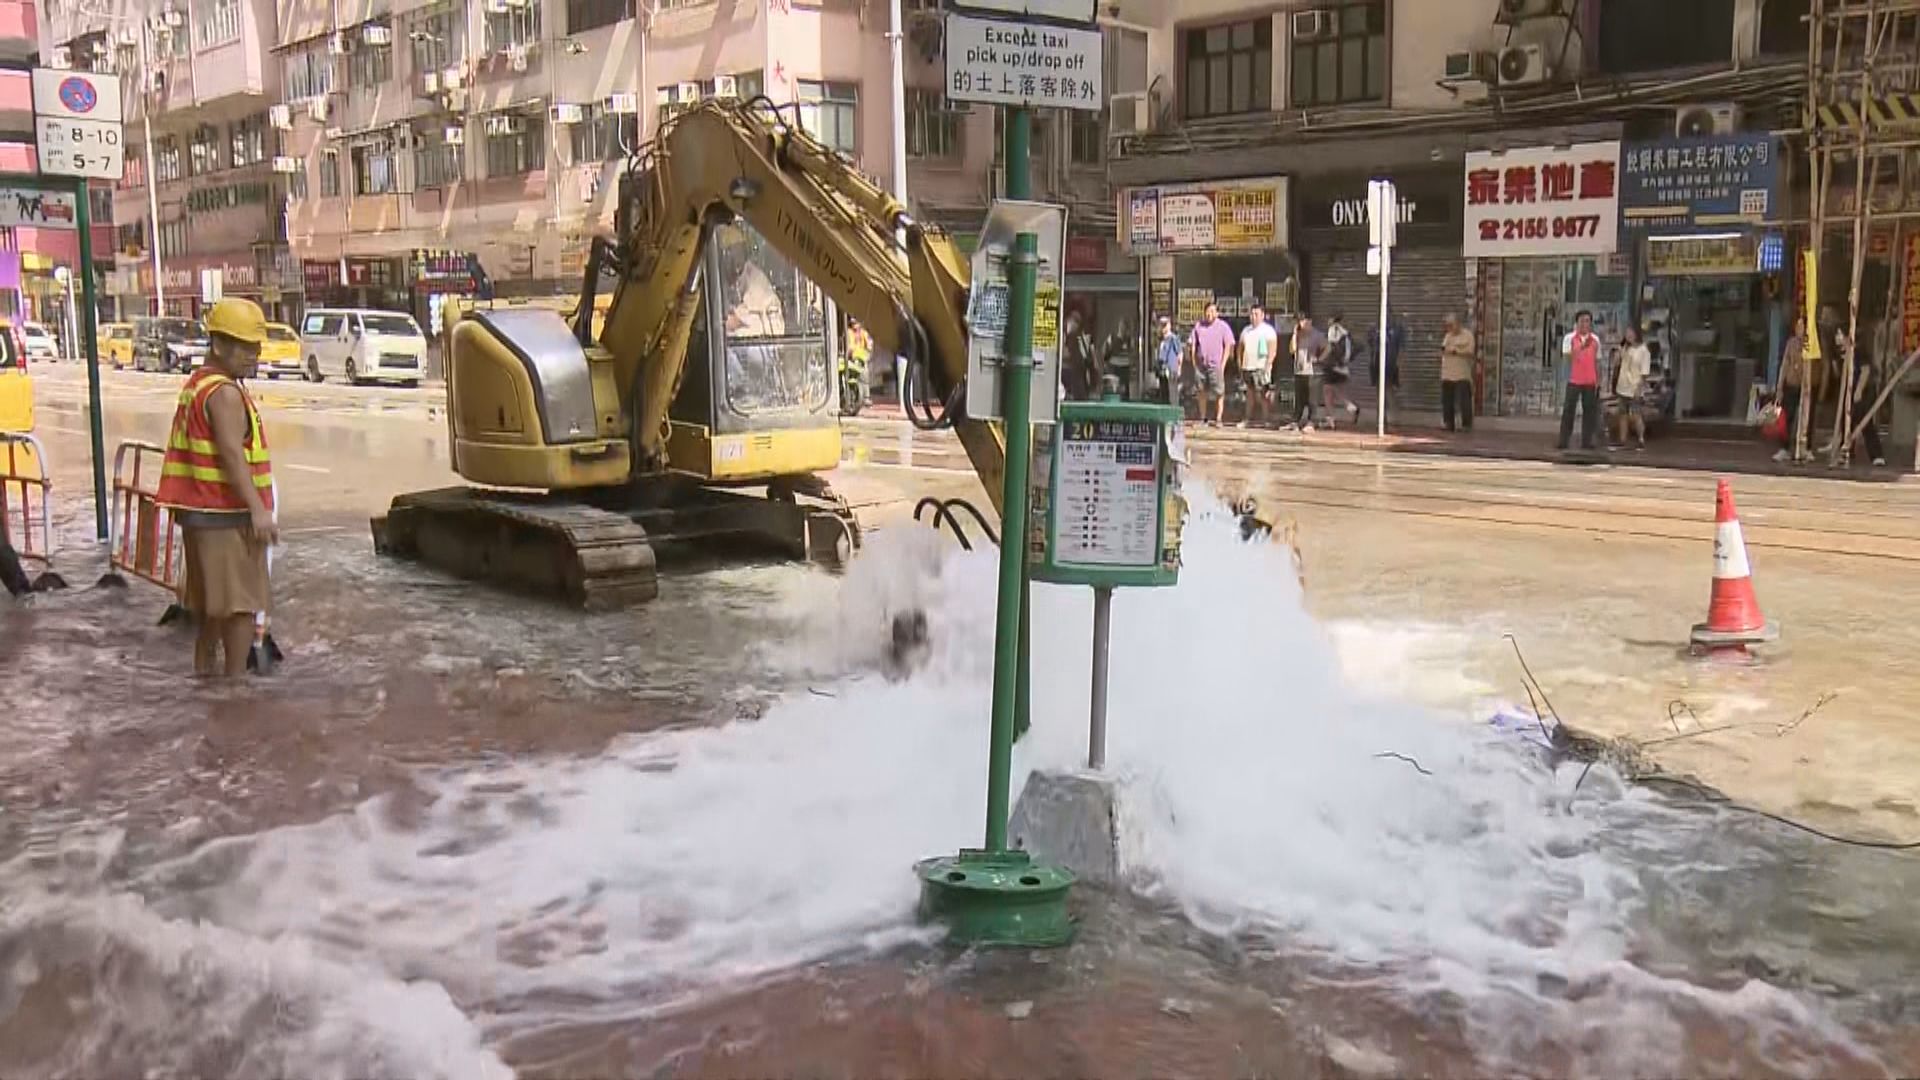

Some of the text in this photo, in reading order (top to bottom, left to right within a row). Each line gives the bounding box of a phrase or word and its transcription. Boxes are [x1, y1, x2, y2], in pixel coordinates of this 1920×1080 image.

[985, 27, 1069, 49] Except taxi
[967, 46, 1085, 70] pick up/drop off
[953, 69, 1096, 100] 的士上落客除外
[71, 128, 118, 145] 8-10
[73, 154, 111, 171] 5-7
[1468, 160, 1615, 205] 家樂地產
[1071, 423, 1094, 440] 20
